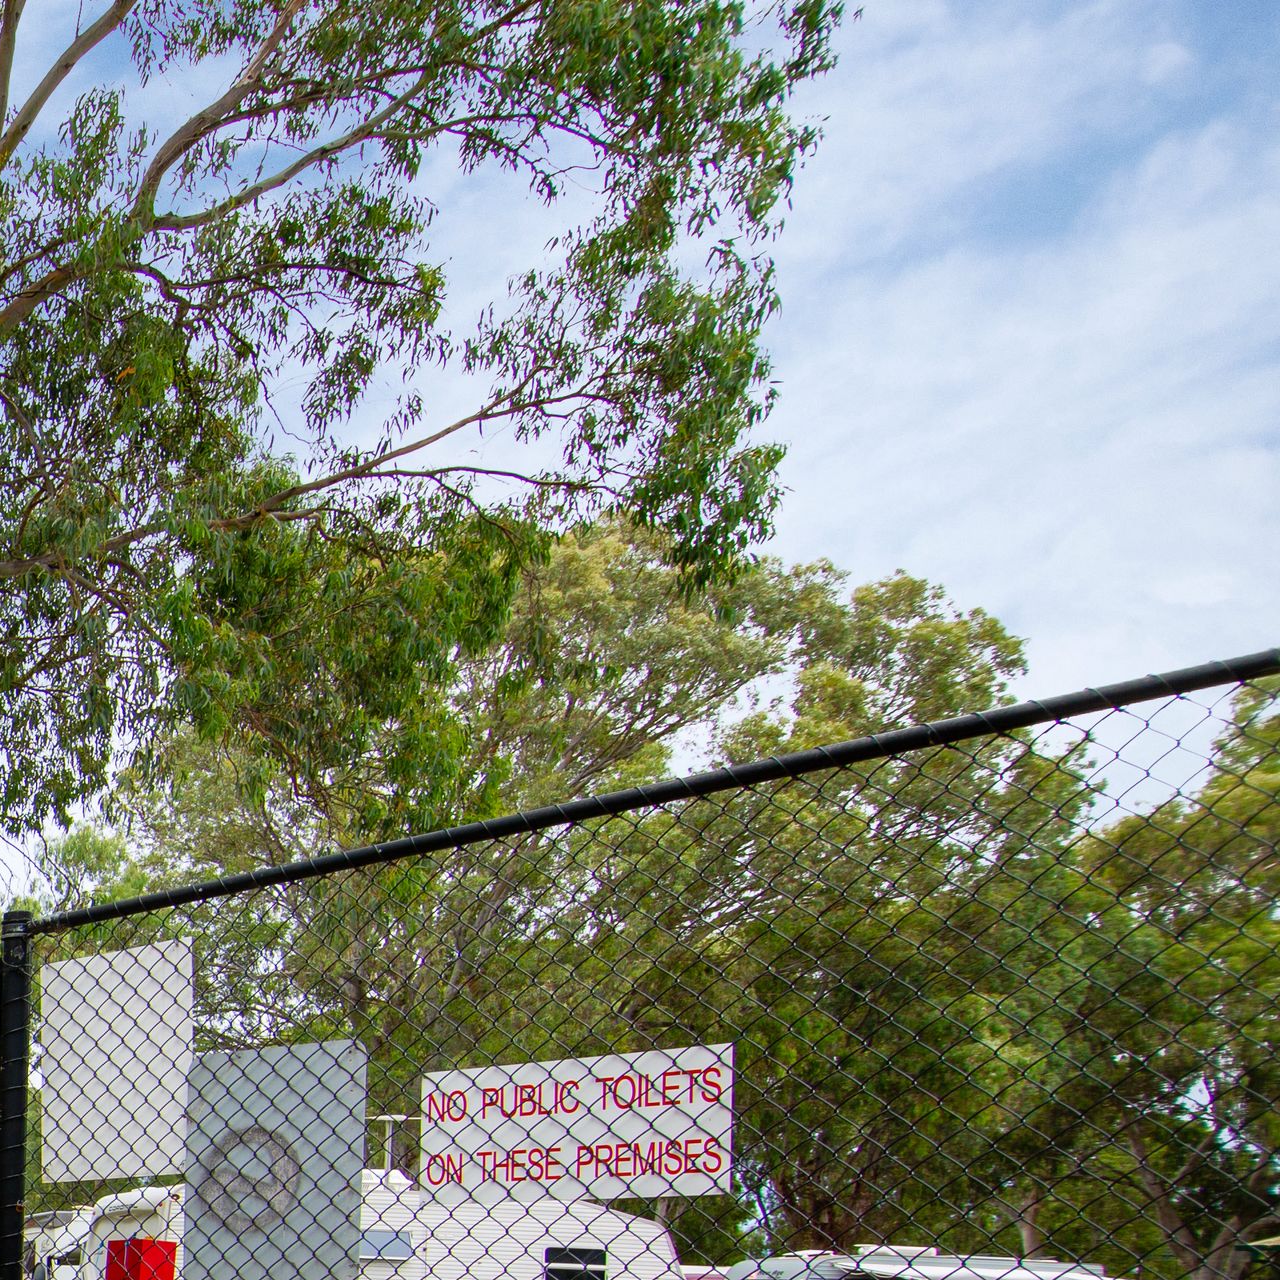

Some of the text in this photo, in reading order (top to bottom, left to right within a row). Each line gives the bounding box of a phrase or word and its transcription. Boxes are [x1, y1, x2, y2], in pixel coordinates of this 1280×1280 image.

[427, 1067, 722, 1123] NO PUBLIC TOILETS
[426, 1138, 722, 1186] ON THESE PREMISES
